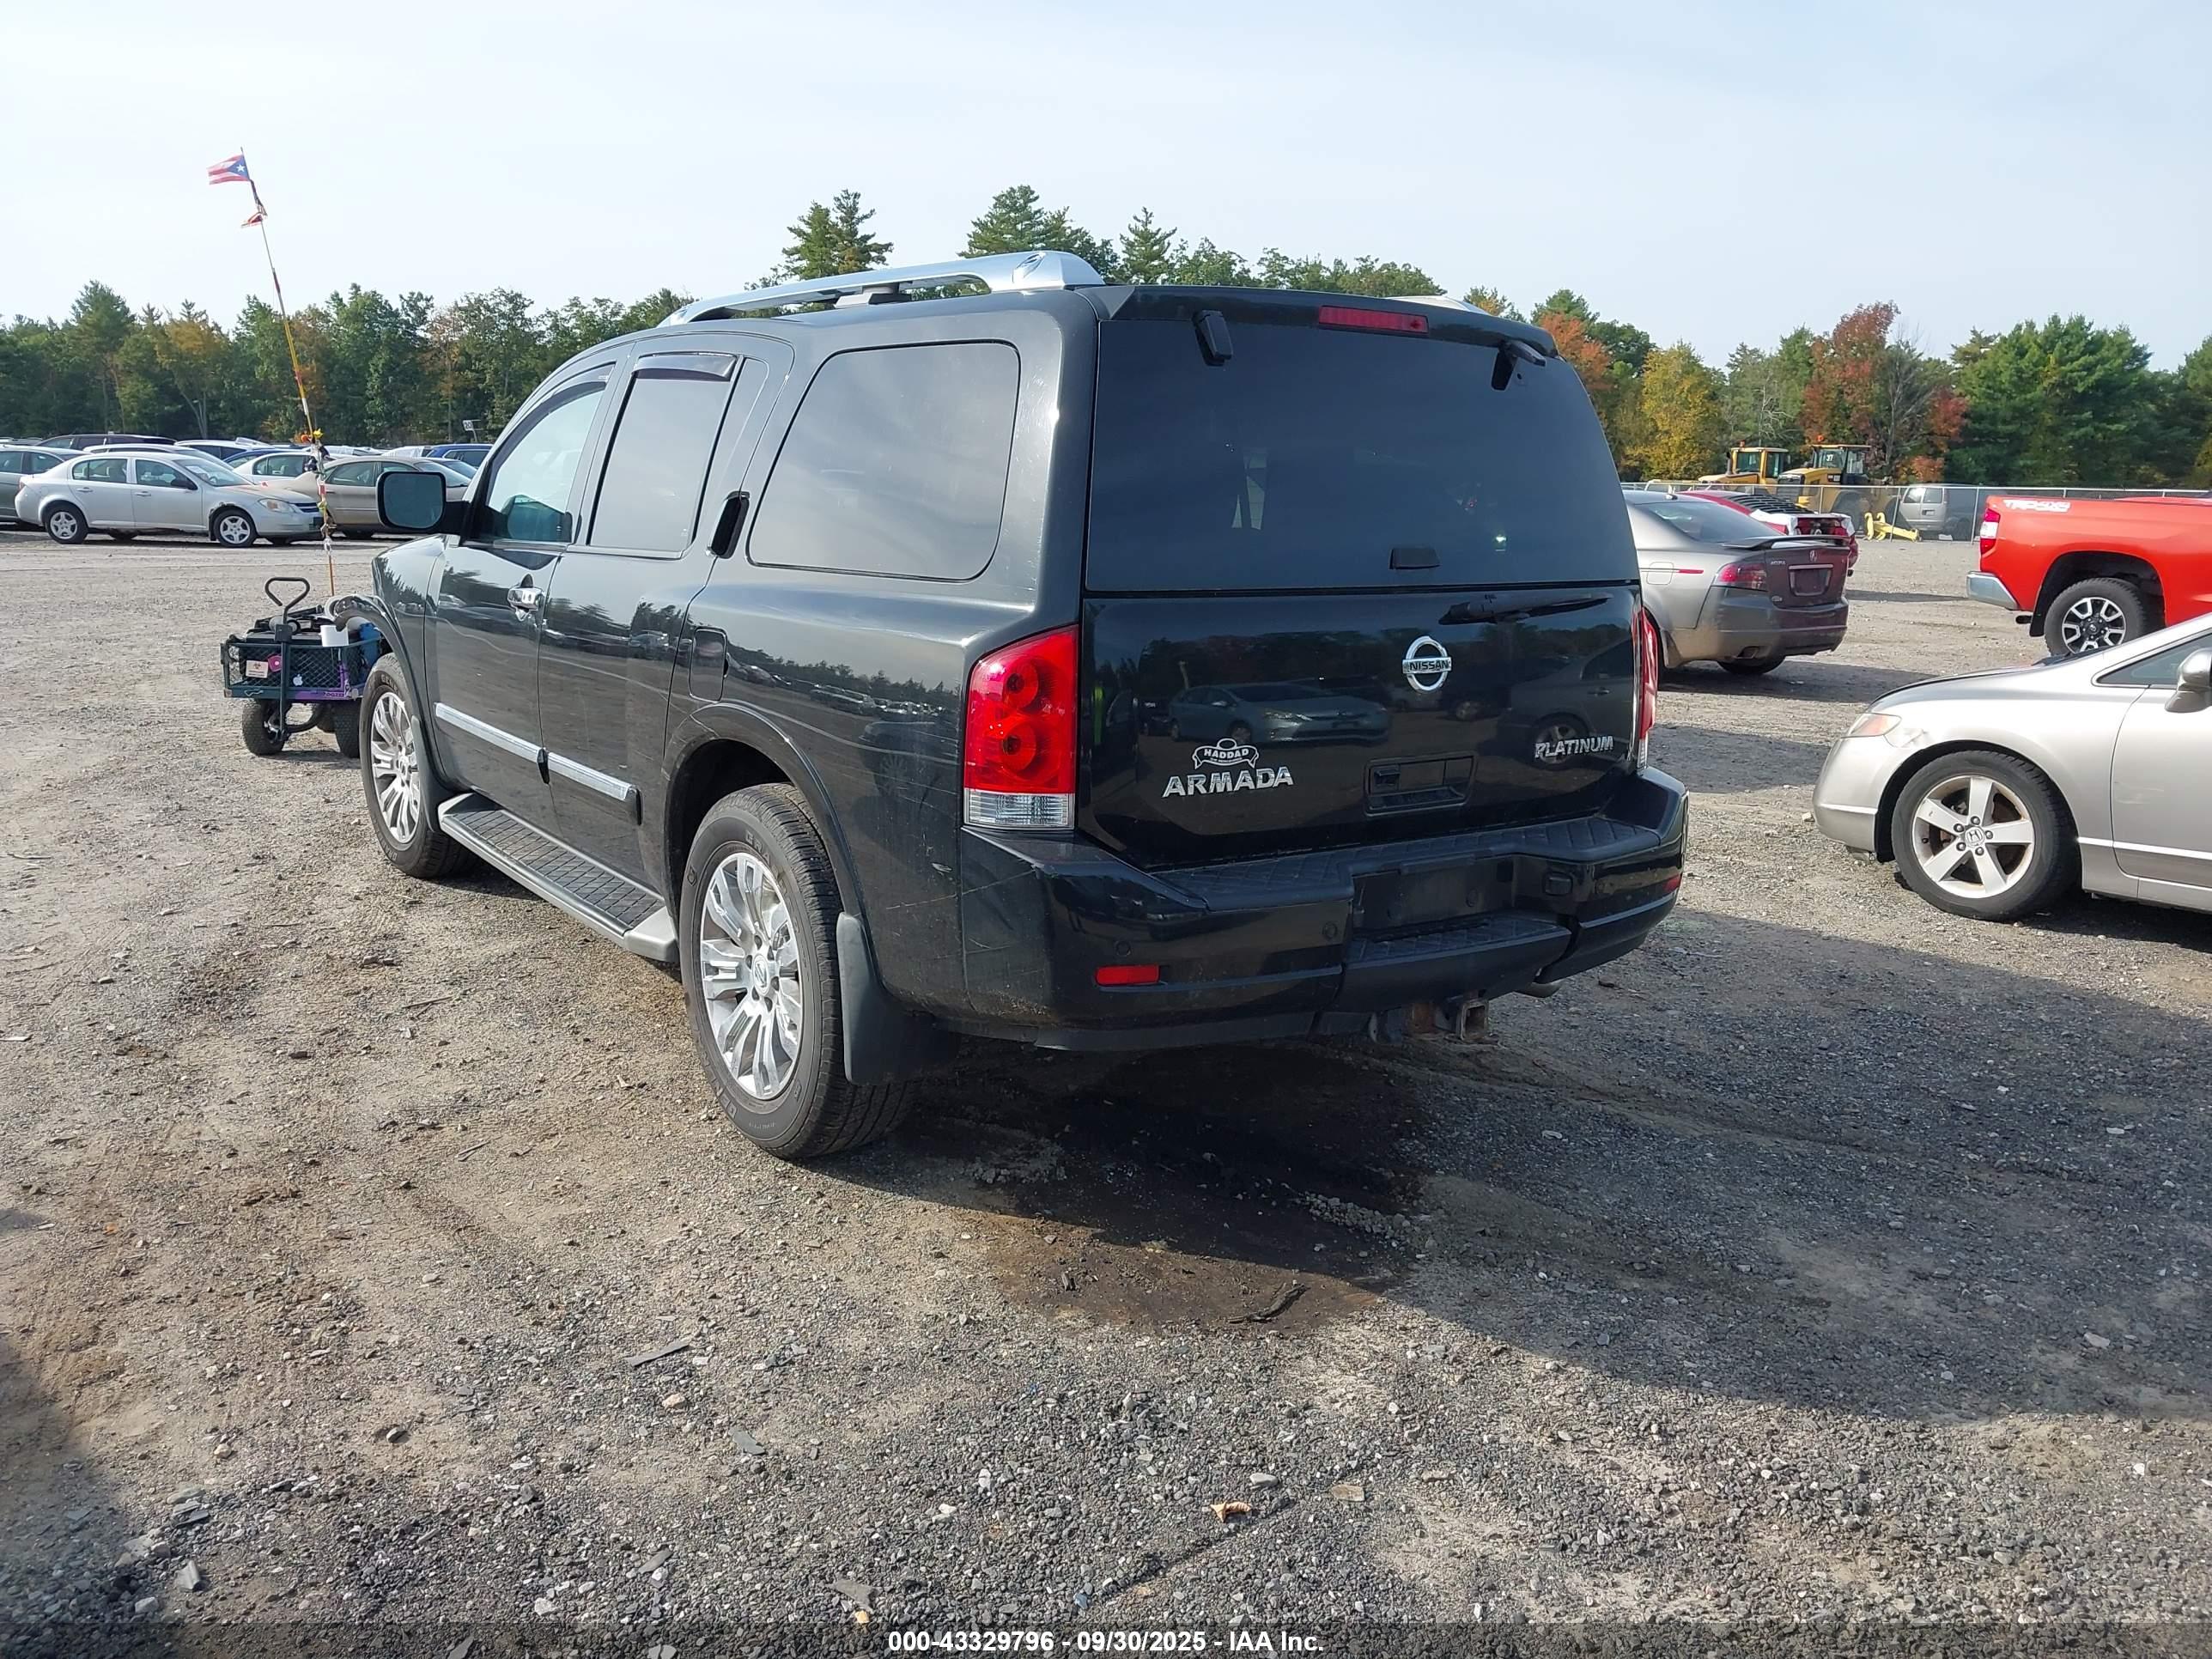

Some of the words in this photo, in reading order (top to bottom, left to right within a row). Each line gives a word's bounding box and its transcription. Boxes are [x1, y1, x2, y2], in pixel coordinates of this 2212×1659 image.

[1409, 659, 1449, 671] NISSAN
[1204, 748, 1249, 759] HADDAD
[1534, 735, 1613, 758] PLATINUM
[1162, 767, 1294, 798] ARMADA
